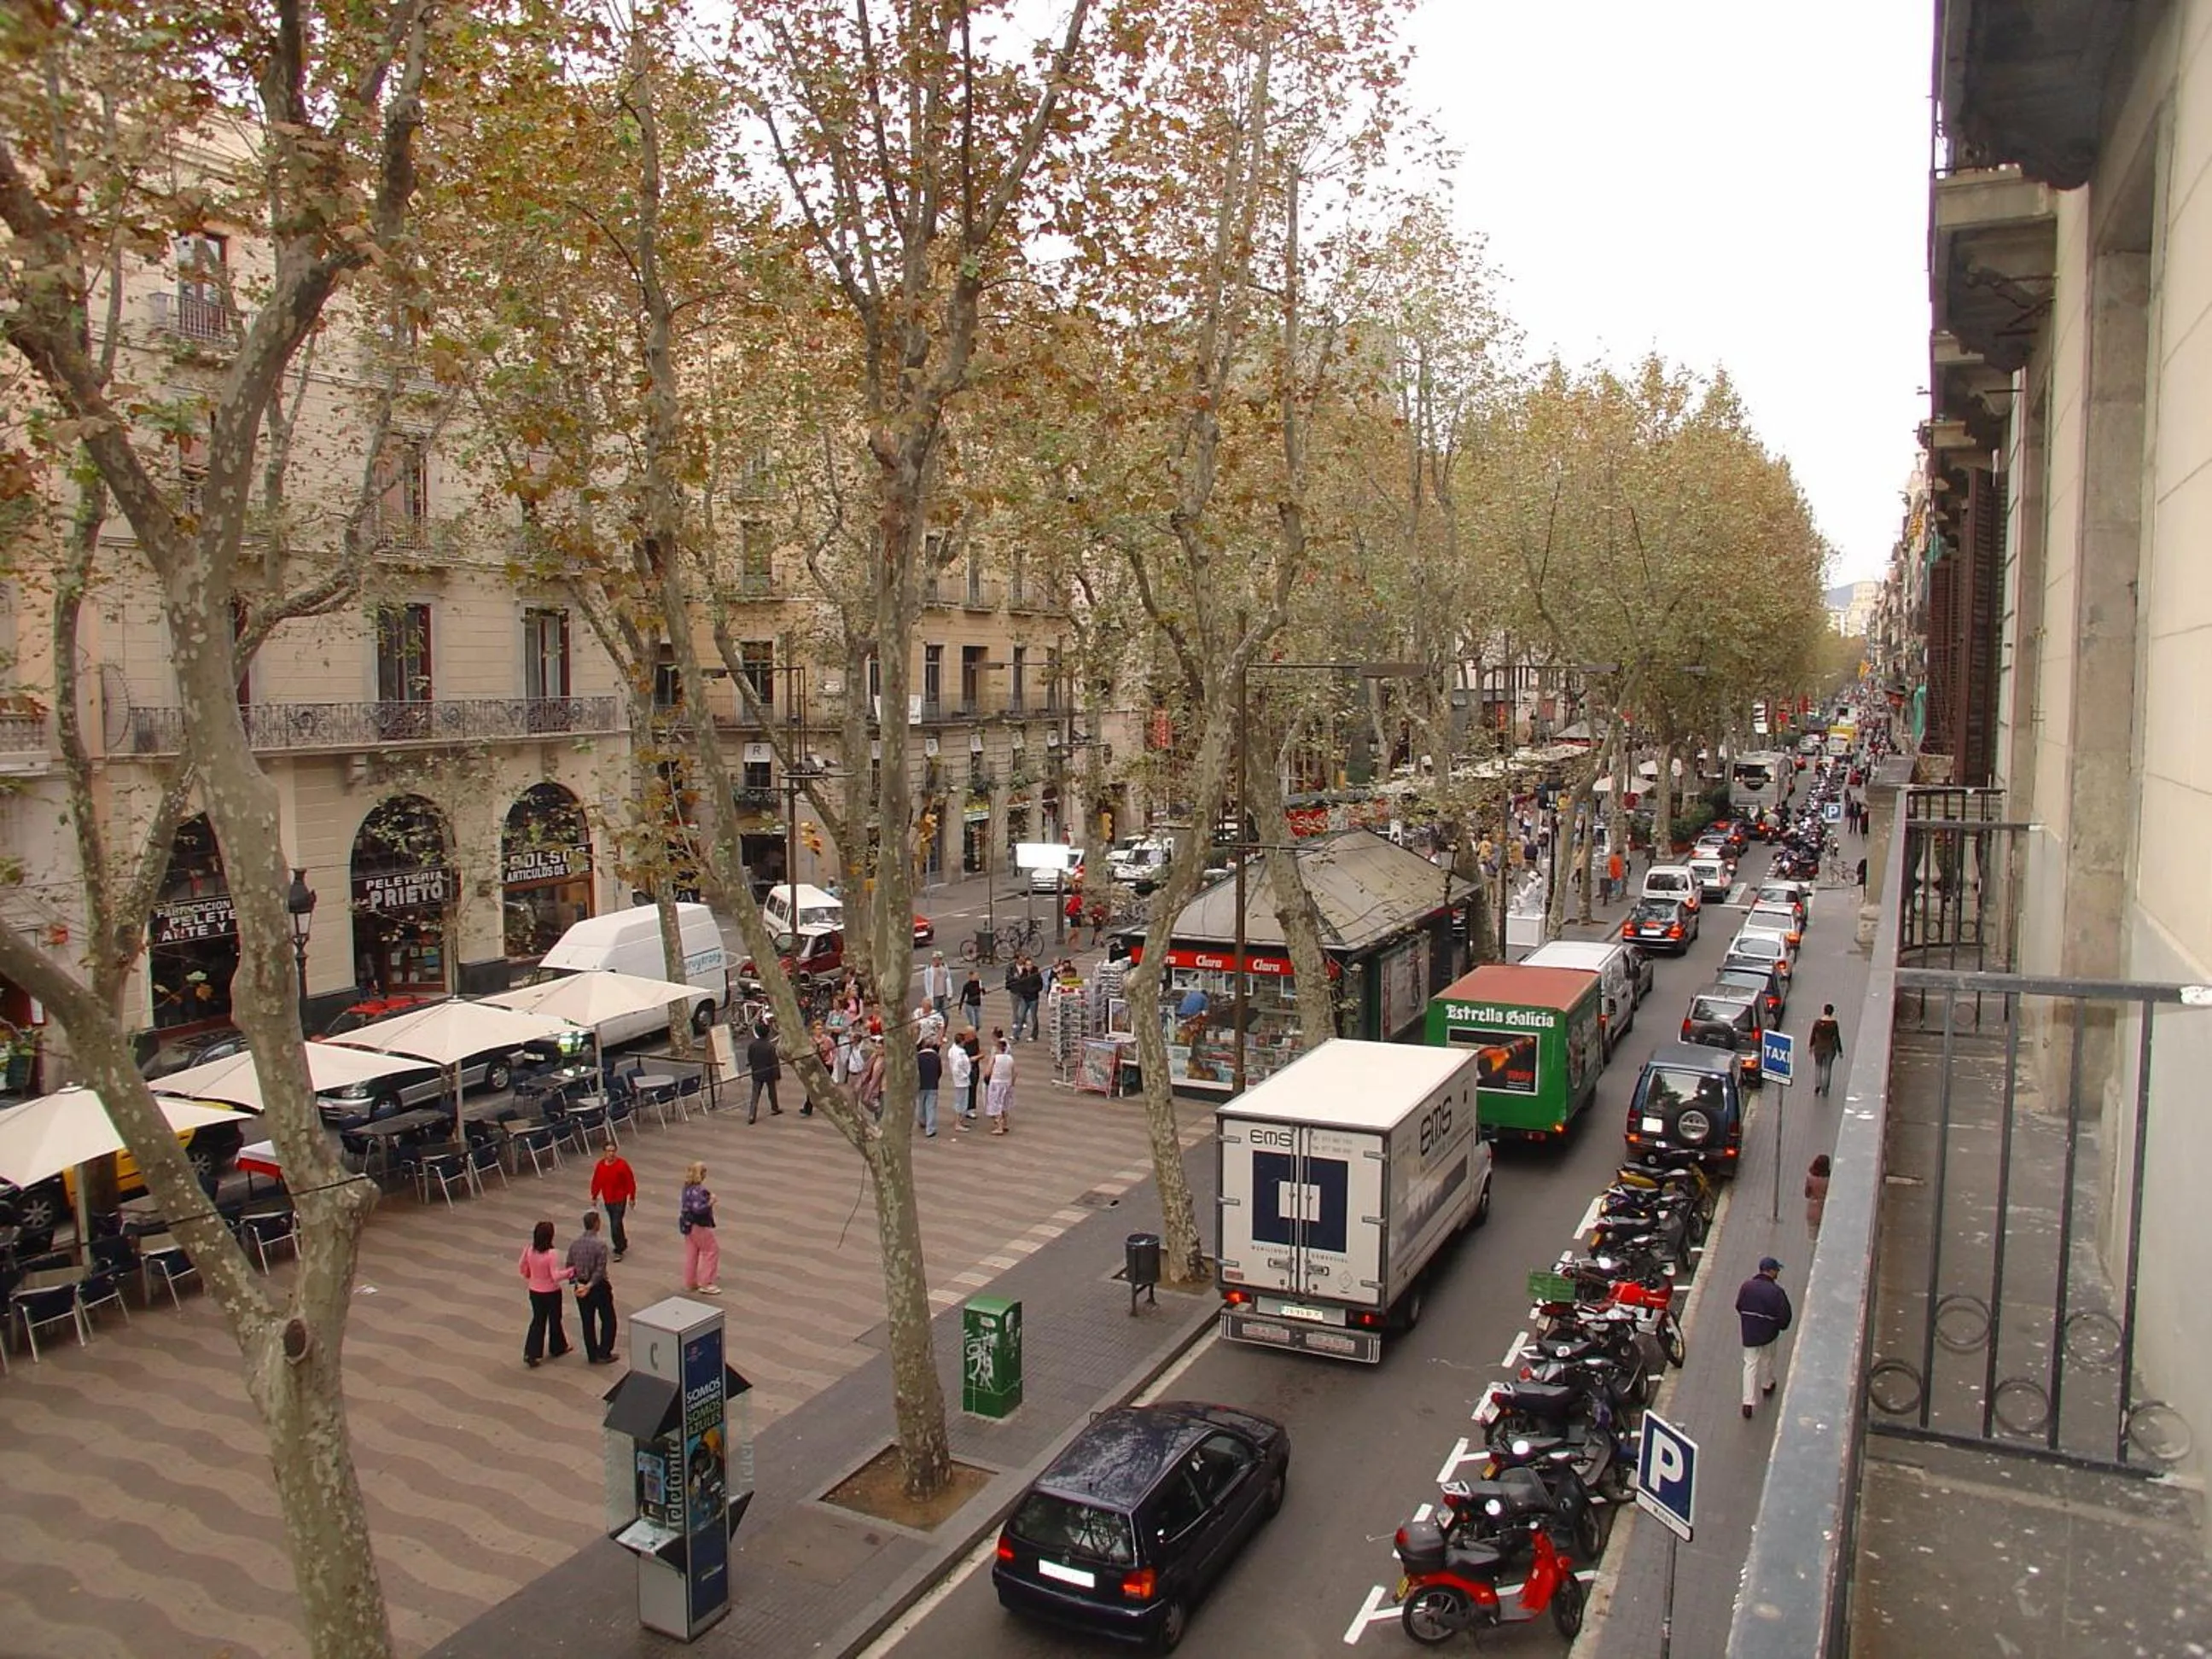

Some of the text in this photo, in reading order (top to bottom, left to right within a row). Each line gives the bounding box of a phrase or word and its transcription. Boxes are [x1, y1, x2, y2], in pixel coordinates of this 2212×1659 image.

[1828, 806, 1838, 818] P
[370, 881, 444, 909] PRIETO
[170, 910, 236, 929] PELETE
[218, 922, 227, 932] Y
[1196, 955, 1223, 969] Clara
[1253, 958, 1280, 972] Clara
[1446, 1004, 1554, 1027] Estrella Galicia
[1765, 1045, 1790, 1063] TAXI
[687, 1377, 721, 1405] SOMOS
[1649, 1428, 1684, 1492] P
[665, 1441, 683, 1528] Telefonic
